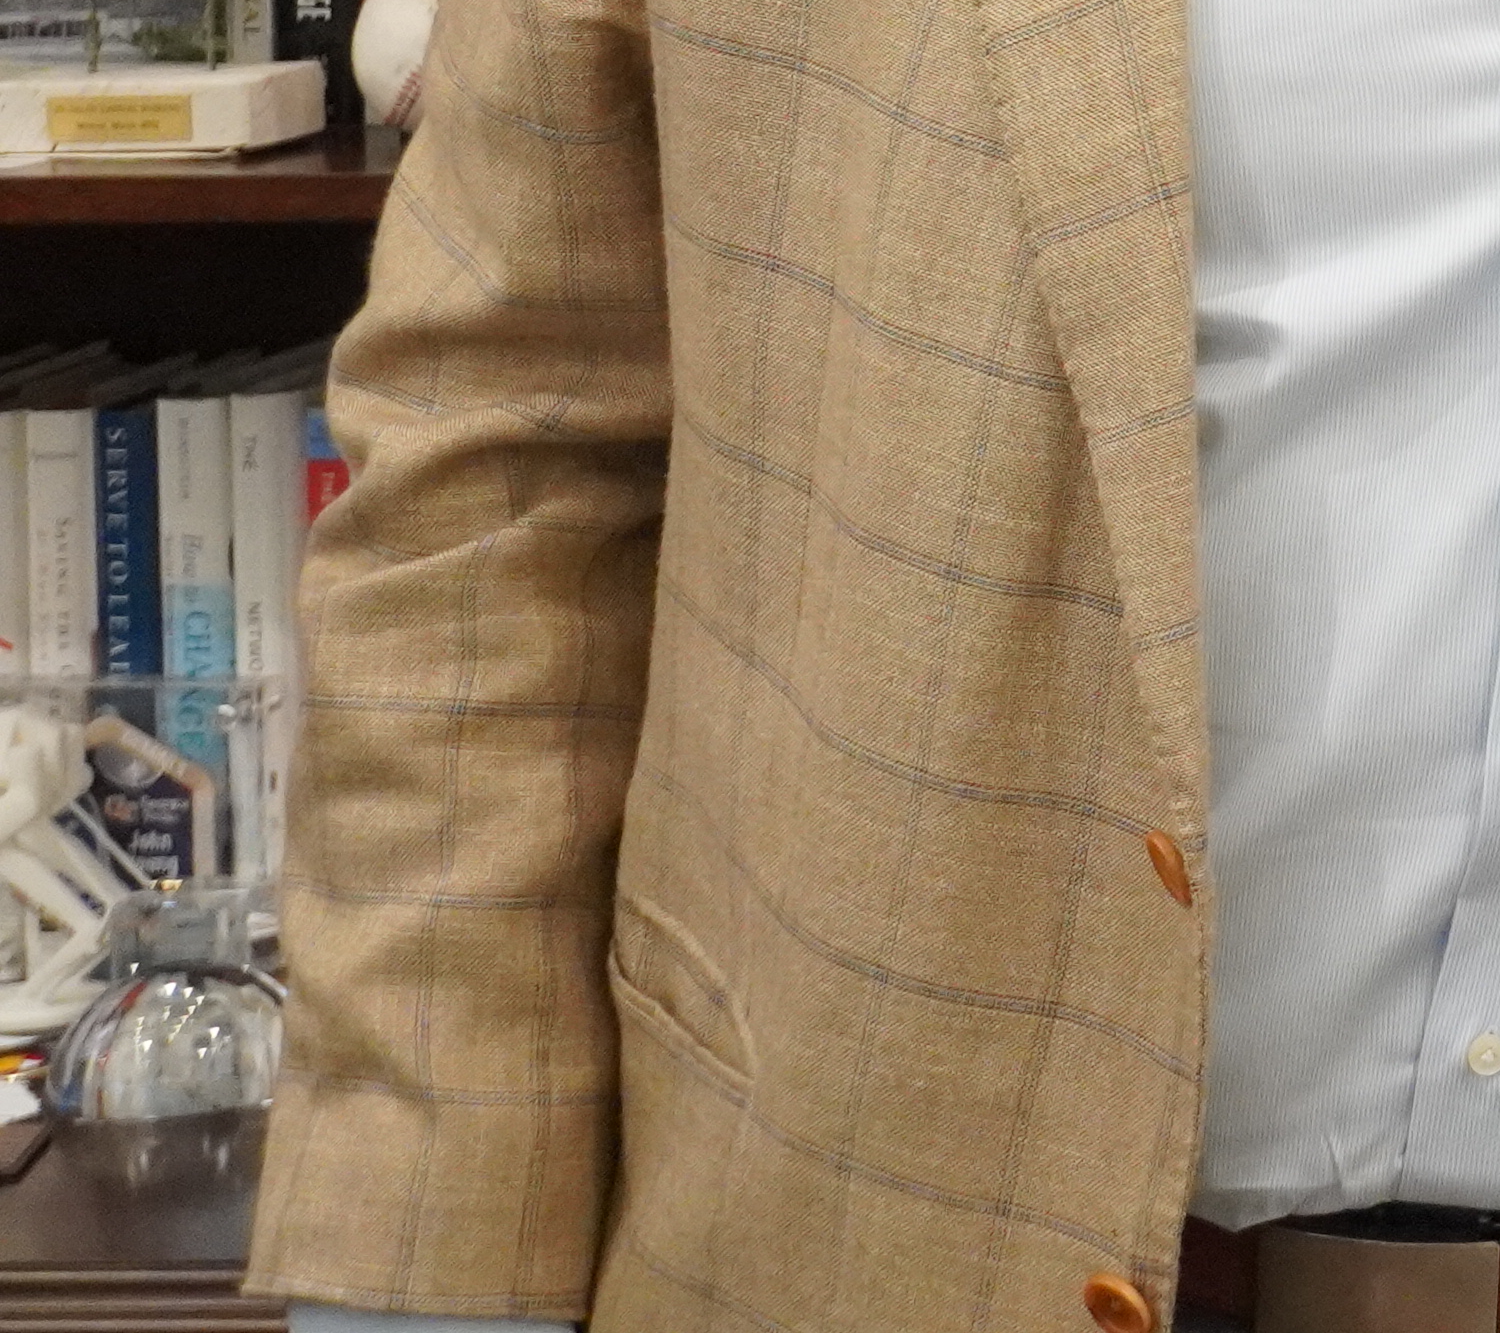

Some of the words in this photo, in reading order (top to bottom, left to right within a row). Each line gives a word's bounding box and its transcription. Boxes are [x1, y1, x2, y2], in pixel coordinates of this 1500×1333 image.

[241, 435, 258, 473] THE
[105, 426, 130, 531] SERVE
[107, 537, 130, 584] TO
[181, 533, 201, 575] How
